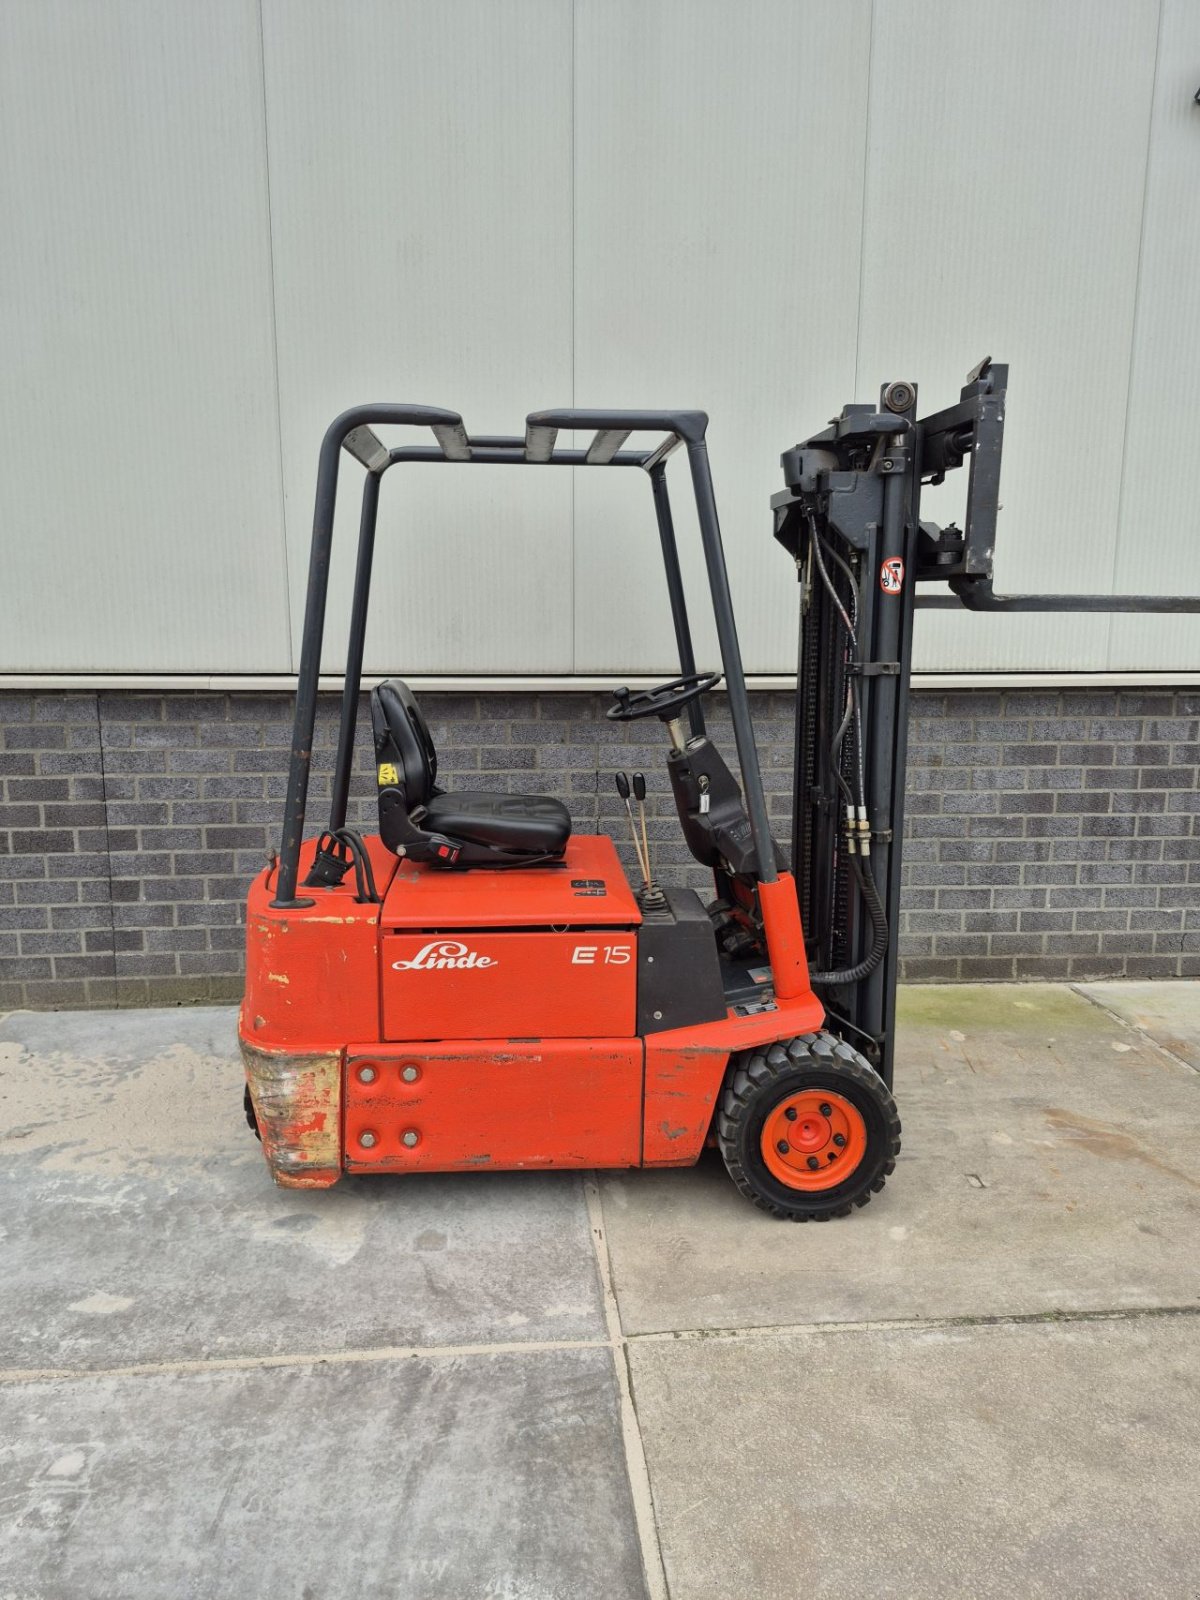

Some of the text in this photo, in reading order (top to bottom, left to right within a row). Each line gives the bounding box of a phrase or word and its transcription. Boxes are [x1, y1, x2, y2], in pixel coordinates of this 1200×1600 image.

[392, 941, 498, 970] Linde
[571, 946, 631, 965] E 15
